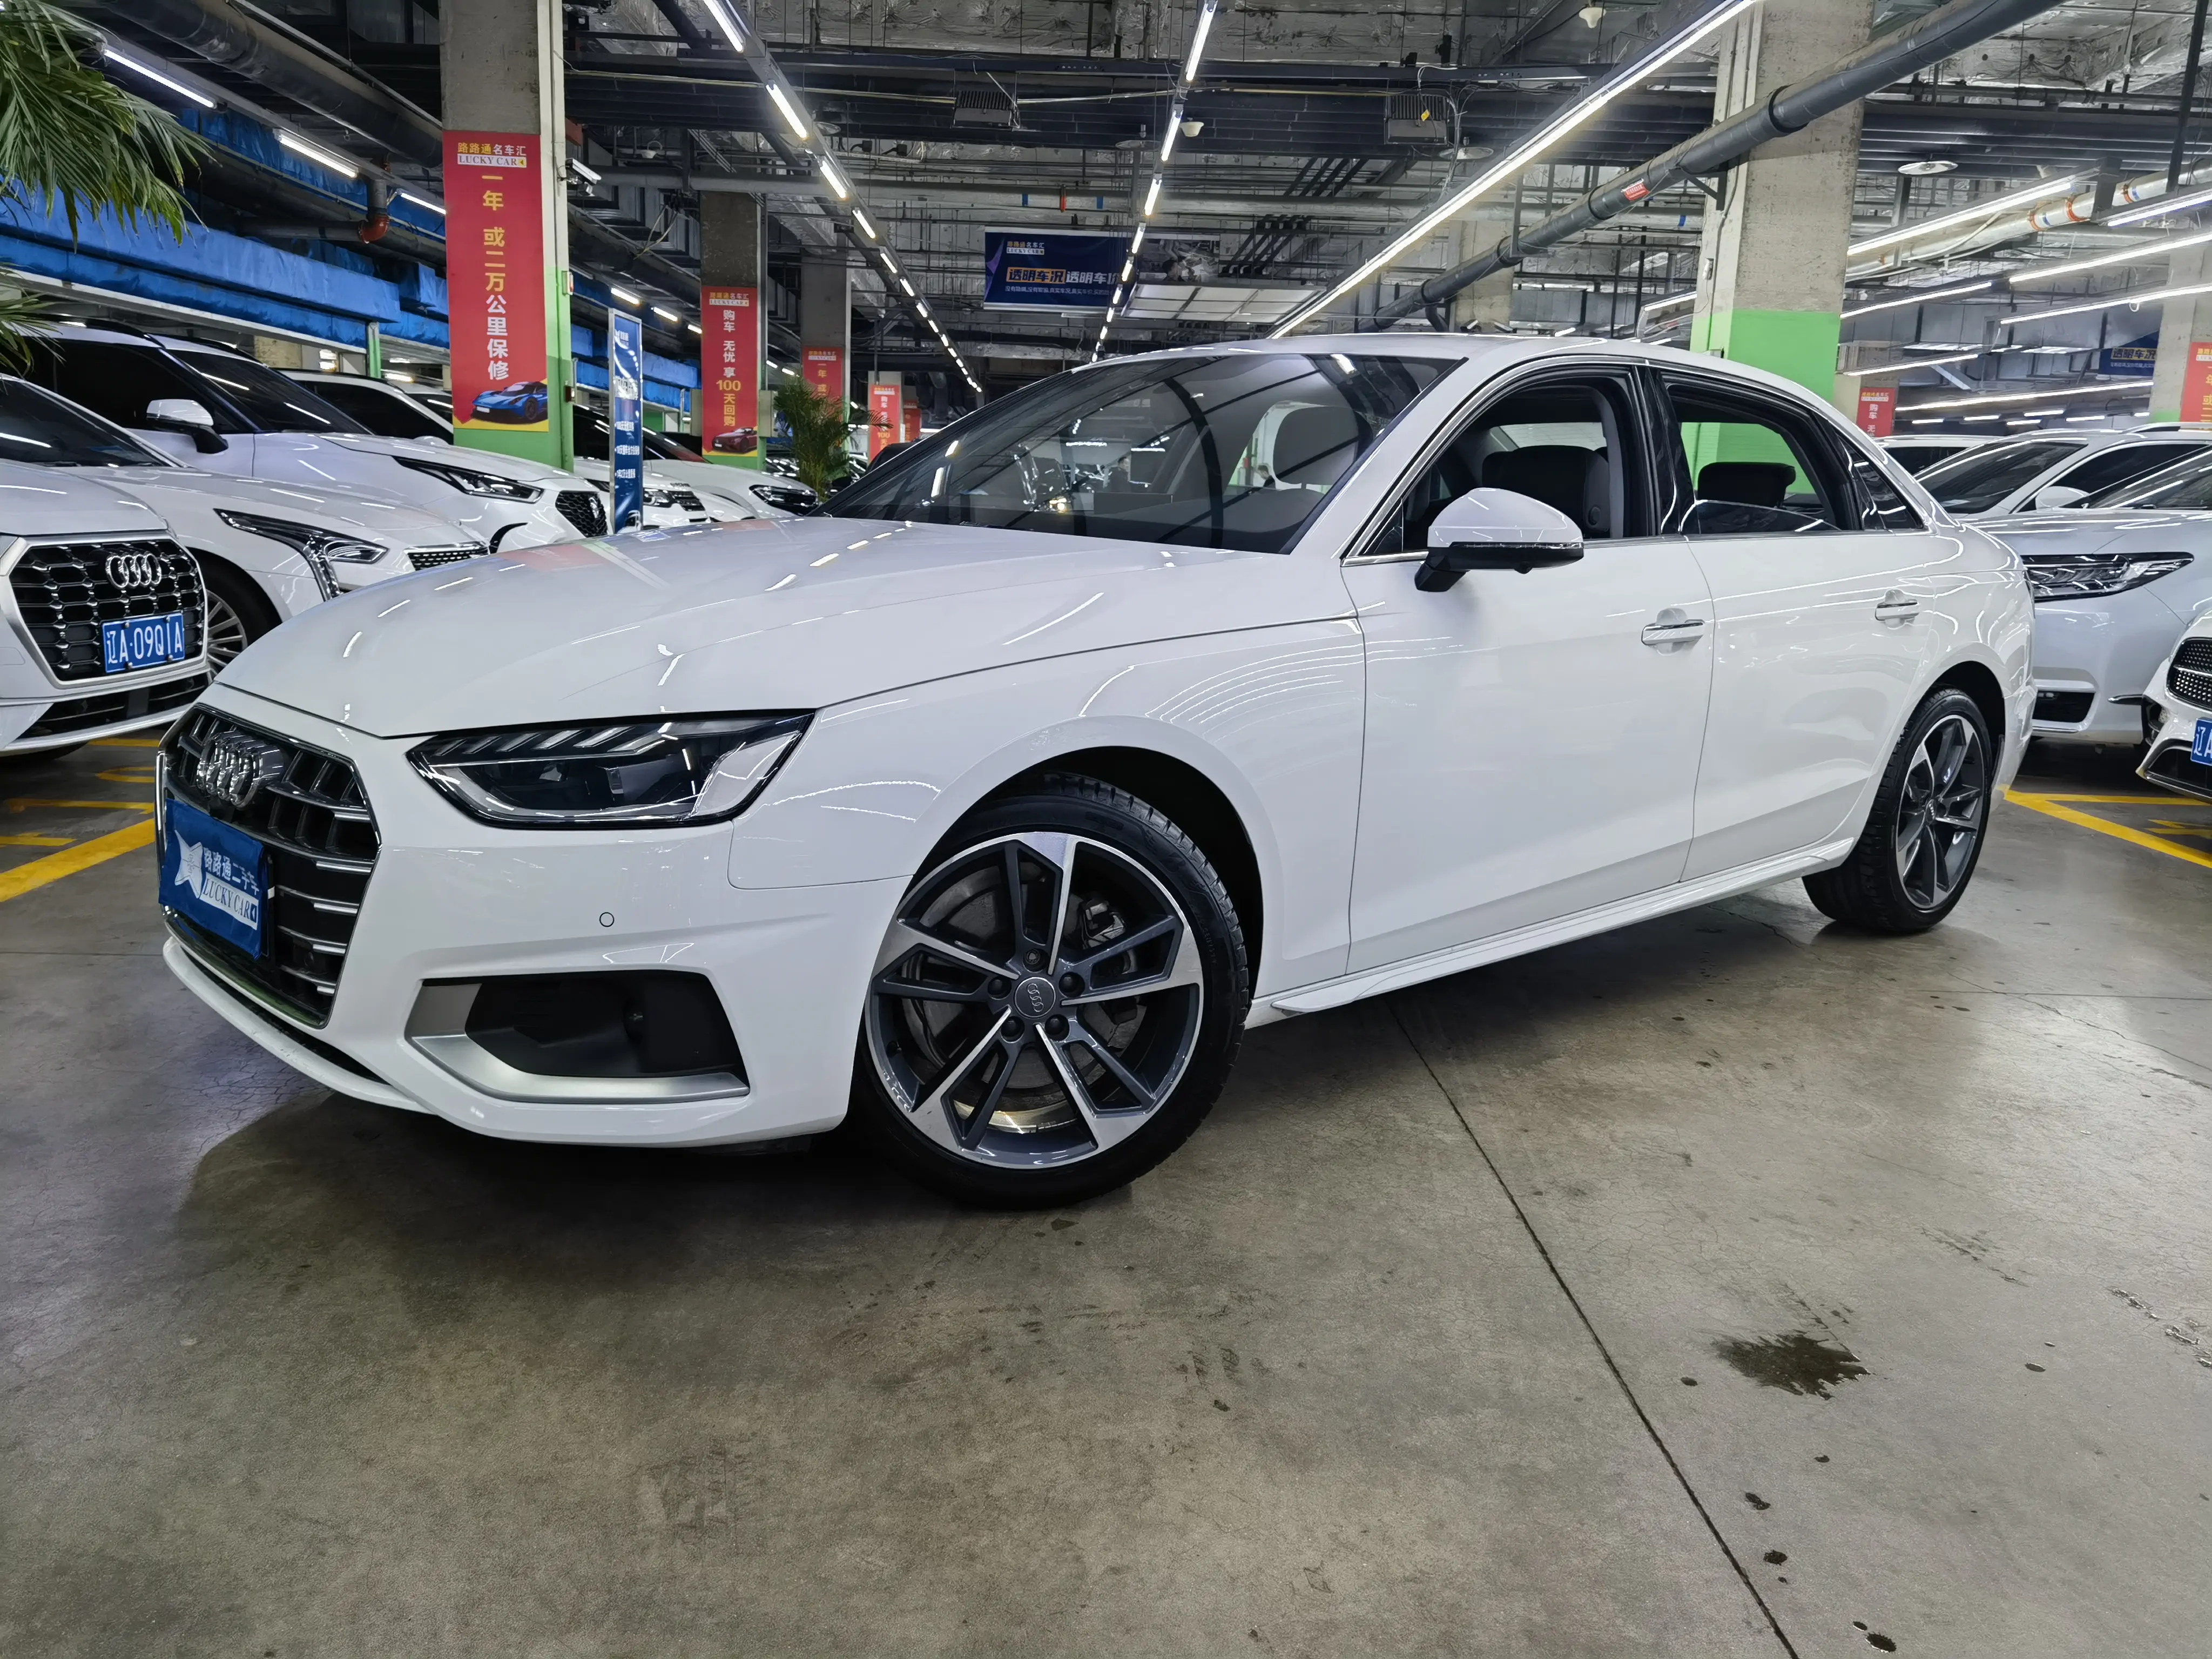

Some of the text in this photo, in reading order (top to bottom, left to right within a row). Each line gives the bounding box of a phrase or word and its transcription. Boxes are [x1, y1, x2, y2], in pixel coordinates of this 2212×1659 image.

[458, 143, 527, 156] 路路通名车汇
[459, 156, 517, 165] LUCKY CAR
[203, 847, 260, 895] 路路通二手车
[203, 878, 250, 920] LUCKY CAR
